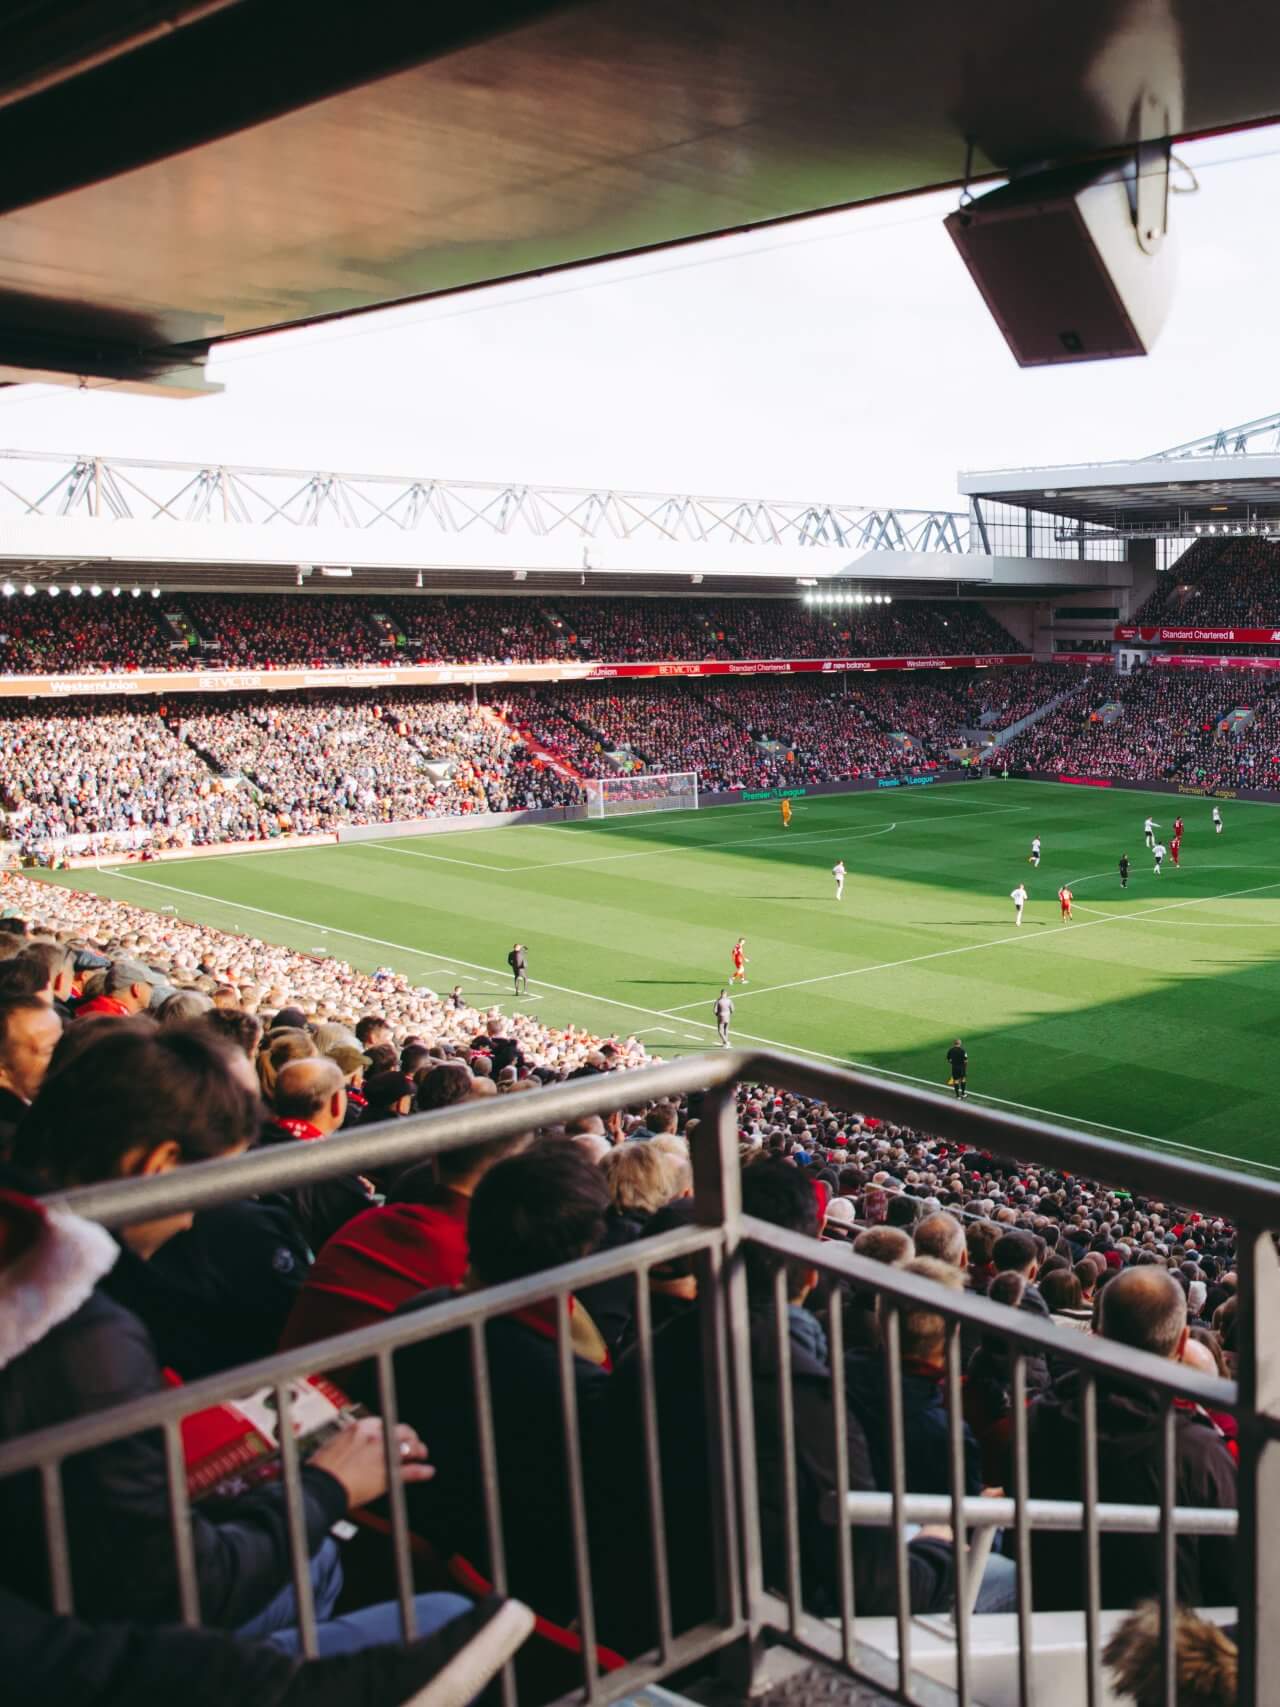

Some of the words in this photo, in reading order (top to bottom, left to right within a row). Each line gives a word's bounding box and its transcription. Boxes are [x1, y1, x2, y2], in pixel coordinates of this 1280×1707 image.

[1162, 630, 1193, 639] Standard
[1194, 630, 1229, 640] Chartered
[728, 664, 756, 672] Standard
[757, 663, 786, 671] Chartered
